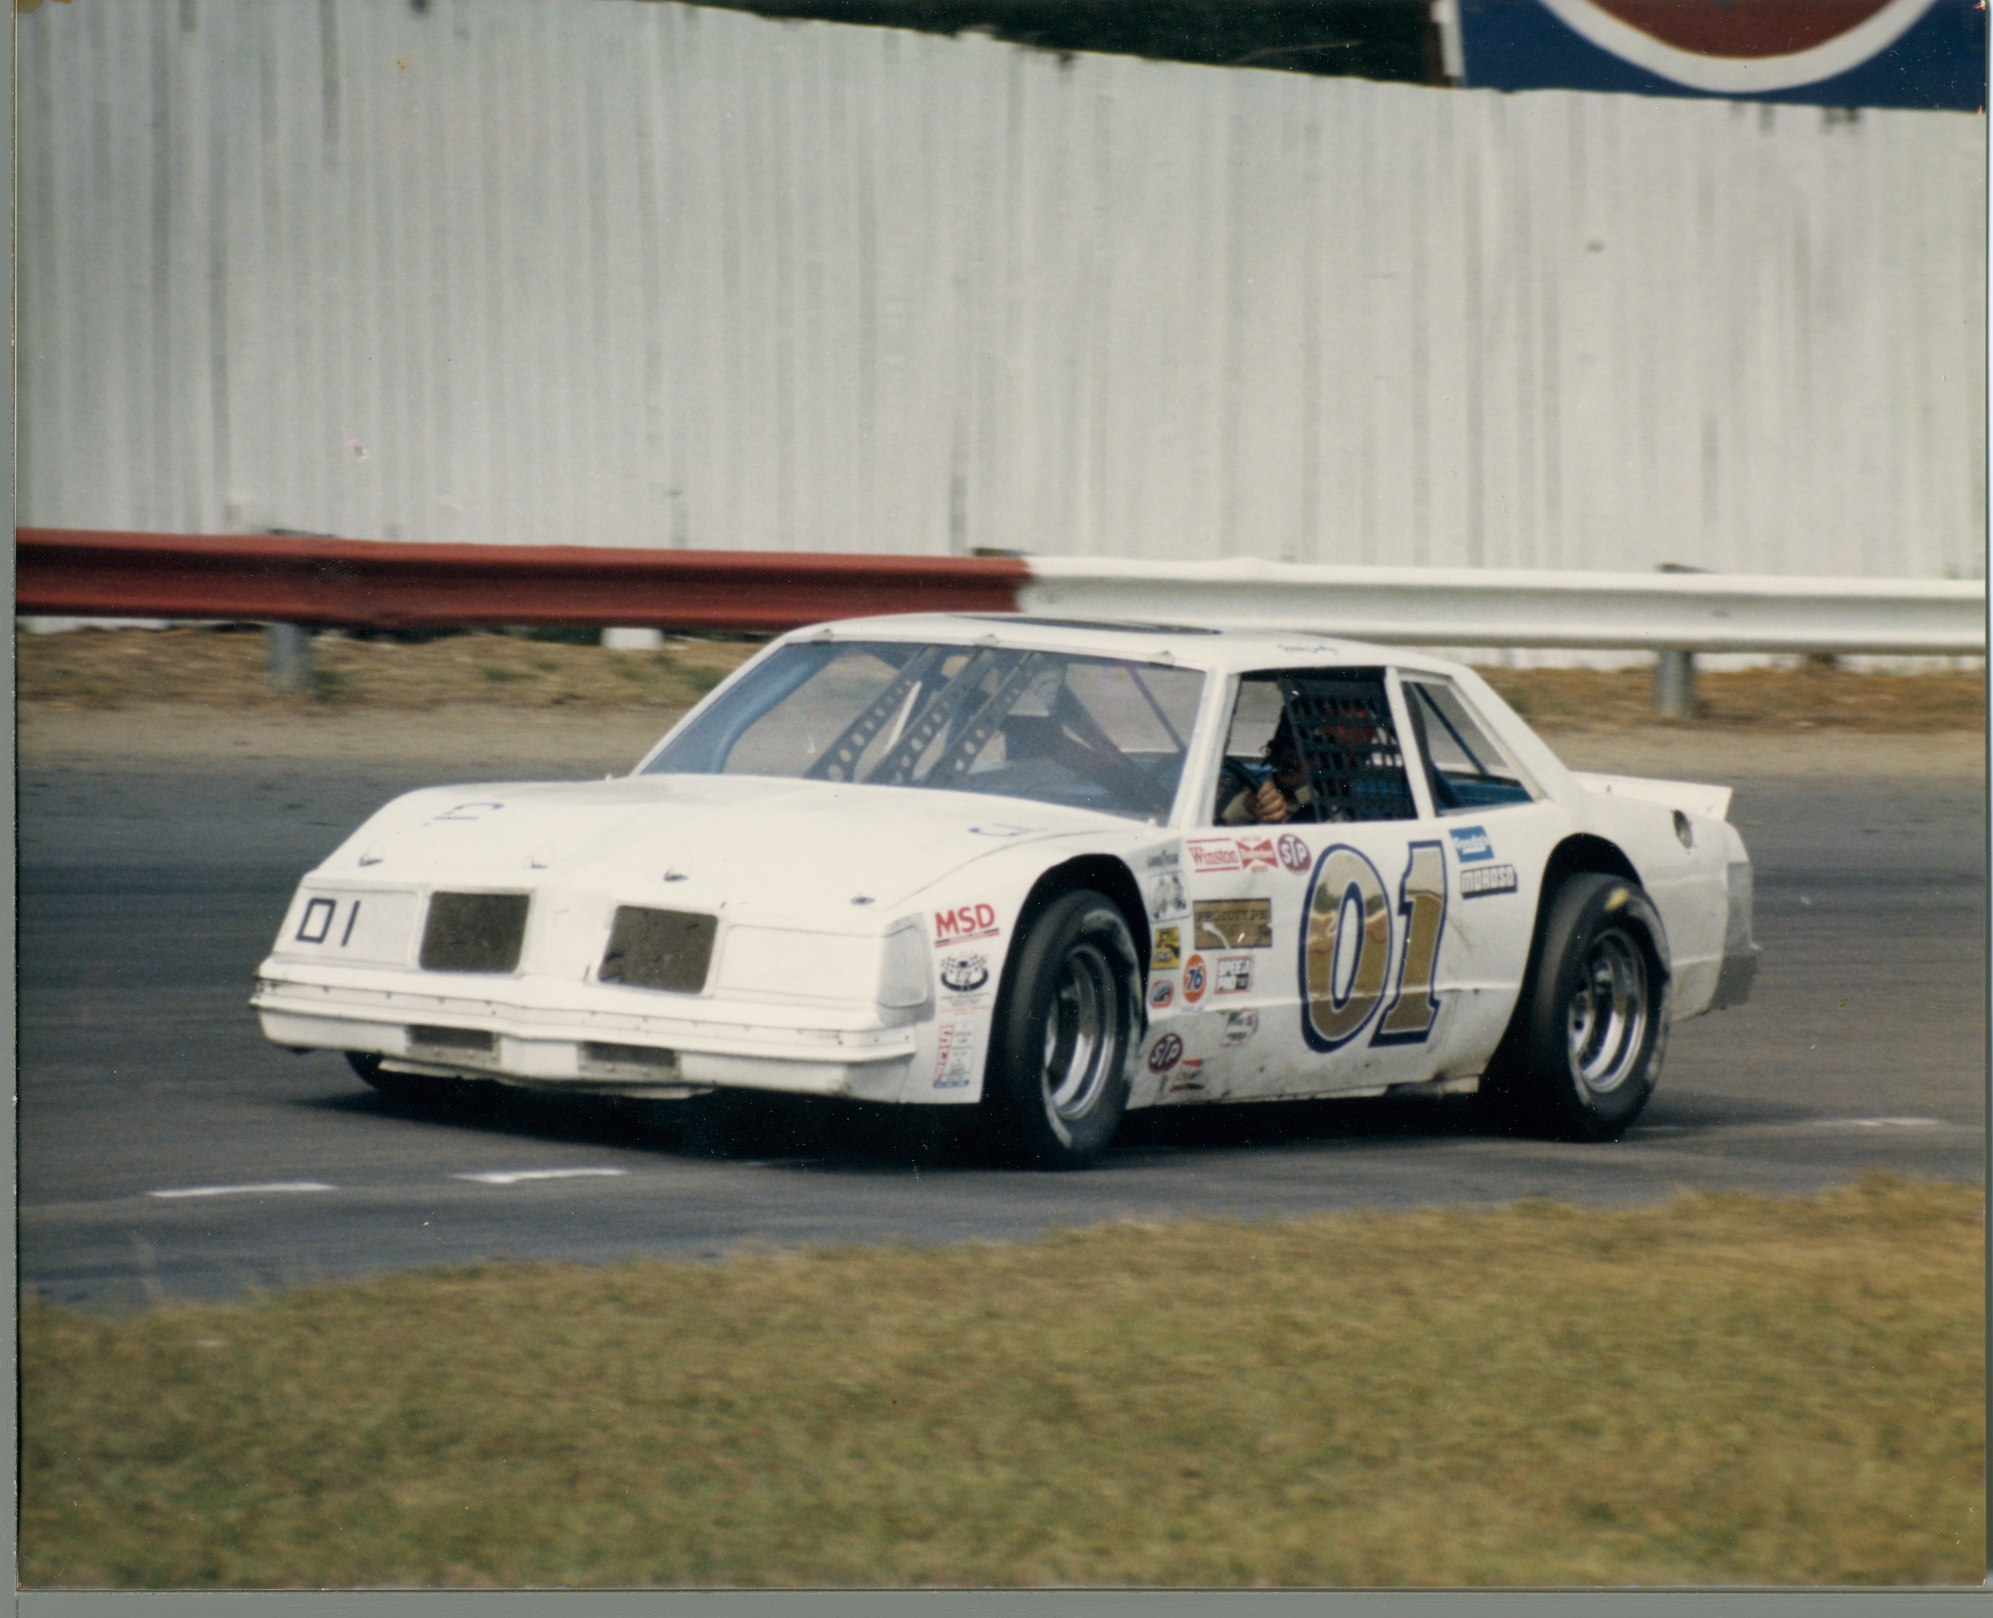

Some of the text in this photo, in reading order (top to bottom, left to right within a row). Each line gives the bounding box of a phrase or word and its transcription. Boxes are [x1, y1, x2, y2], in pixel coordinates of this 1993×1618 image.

[1188, 846, 1239, 866] Winston
[1280, 835, 1309, 868] STP
[1461, 866, 1515, 894] MOROSO
[295, 897, 361, 948] 01
[935, 903, 996, 938] MSD
[1298, 839, 1448, 1054] 01
[1187, 965, 1204, 991] 76
[1150, 1036, 1181, 1067] STP
